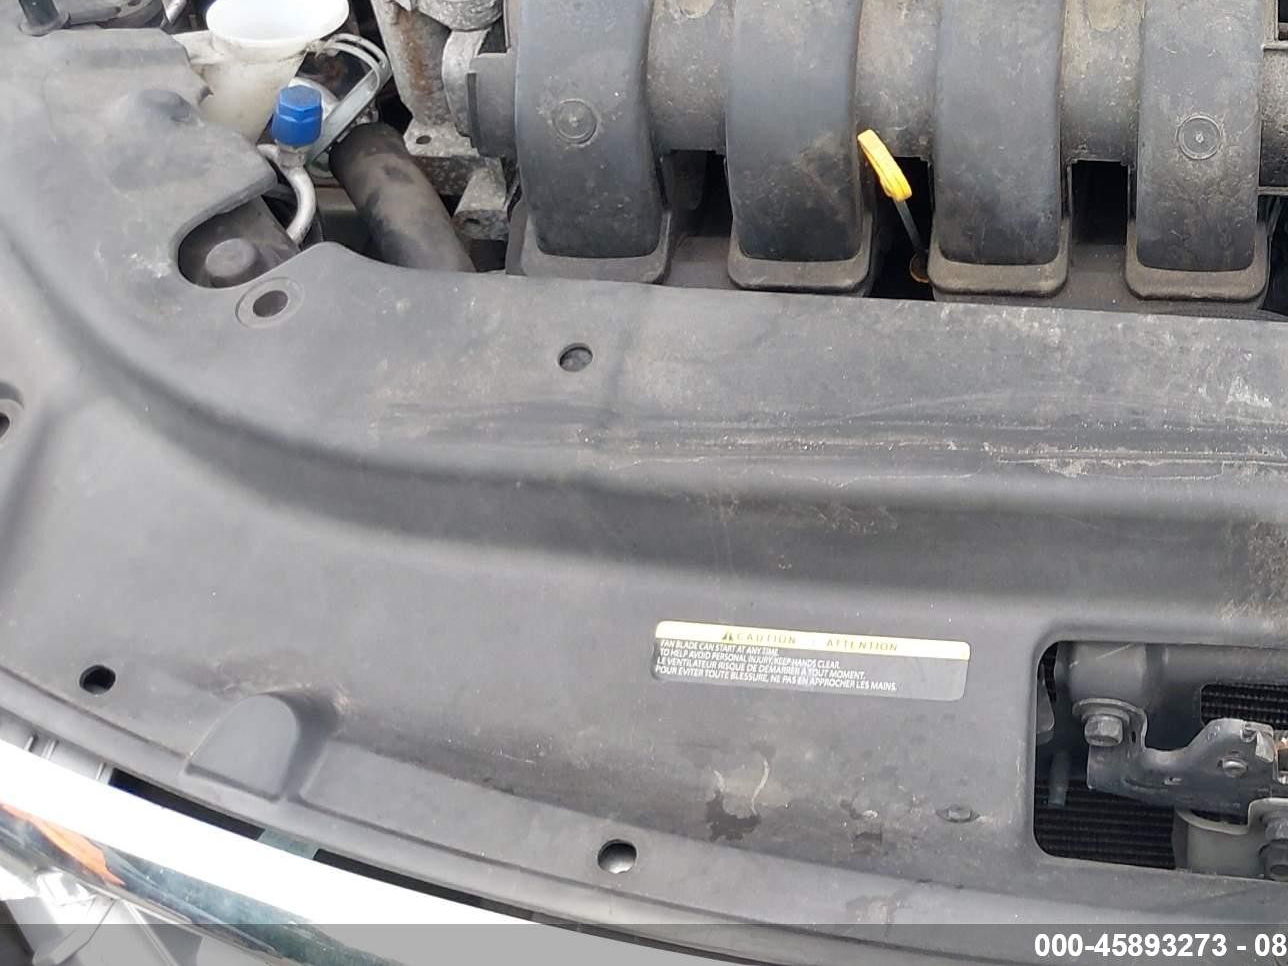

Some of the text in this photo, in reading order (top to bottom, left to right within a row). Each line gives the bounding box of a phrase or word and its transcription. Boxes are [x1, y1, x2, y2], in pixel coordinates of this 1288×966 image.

[660, 639, 675, 648] FAN
[675, 640, 698, 650] BLADE
[699, 642, 715, 651] CAN
[715, 643, 736, 652] START
[736, 645, 746, 653] AT
[746, 645, 761, 654] ANY
[736, 633, 898, 652] CAUTION ATTENTION
[657, 656, 667, 665] LE
[667, 658, 717, 669] VENTILATEUR
[717, 661, 746, 671] RISQUE
[746, 664, 758, 672] DE
[807, 668, 829, 678] TOUT
[829, 670, 866, 681] MOMENT.
[660, 648, 670, 656] TO
[670, 649, 687, 657] HELP
[688, 650, 711, 660] AVOID
[711, 652, 747, 662] PERSONAL
[773, 656, 791, 666] KEEP
[792, 658, 817, 668] HANDS
[817, 660, 841, 670] CLEAR.
[655, 664, 677, 674] POUR
[704, 669, 729, 680] TOUTE
[770, 674, 781, 683] NE
[782, 675, 797, 685] PAS
[797, 676, 809, 686] EN
[809, 677, 856, 689] APPROCHER
[856, 680, 870, 690] LES
[870, 681, 898, 692] MAINS.
